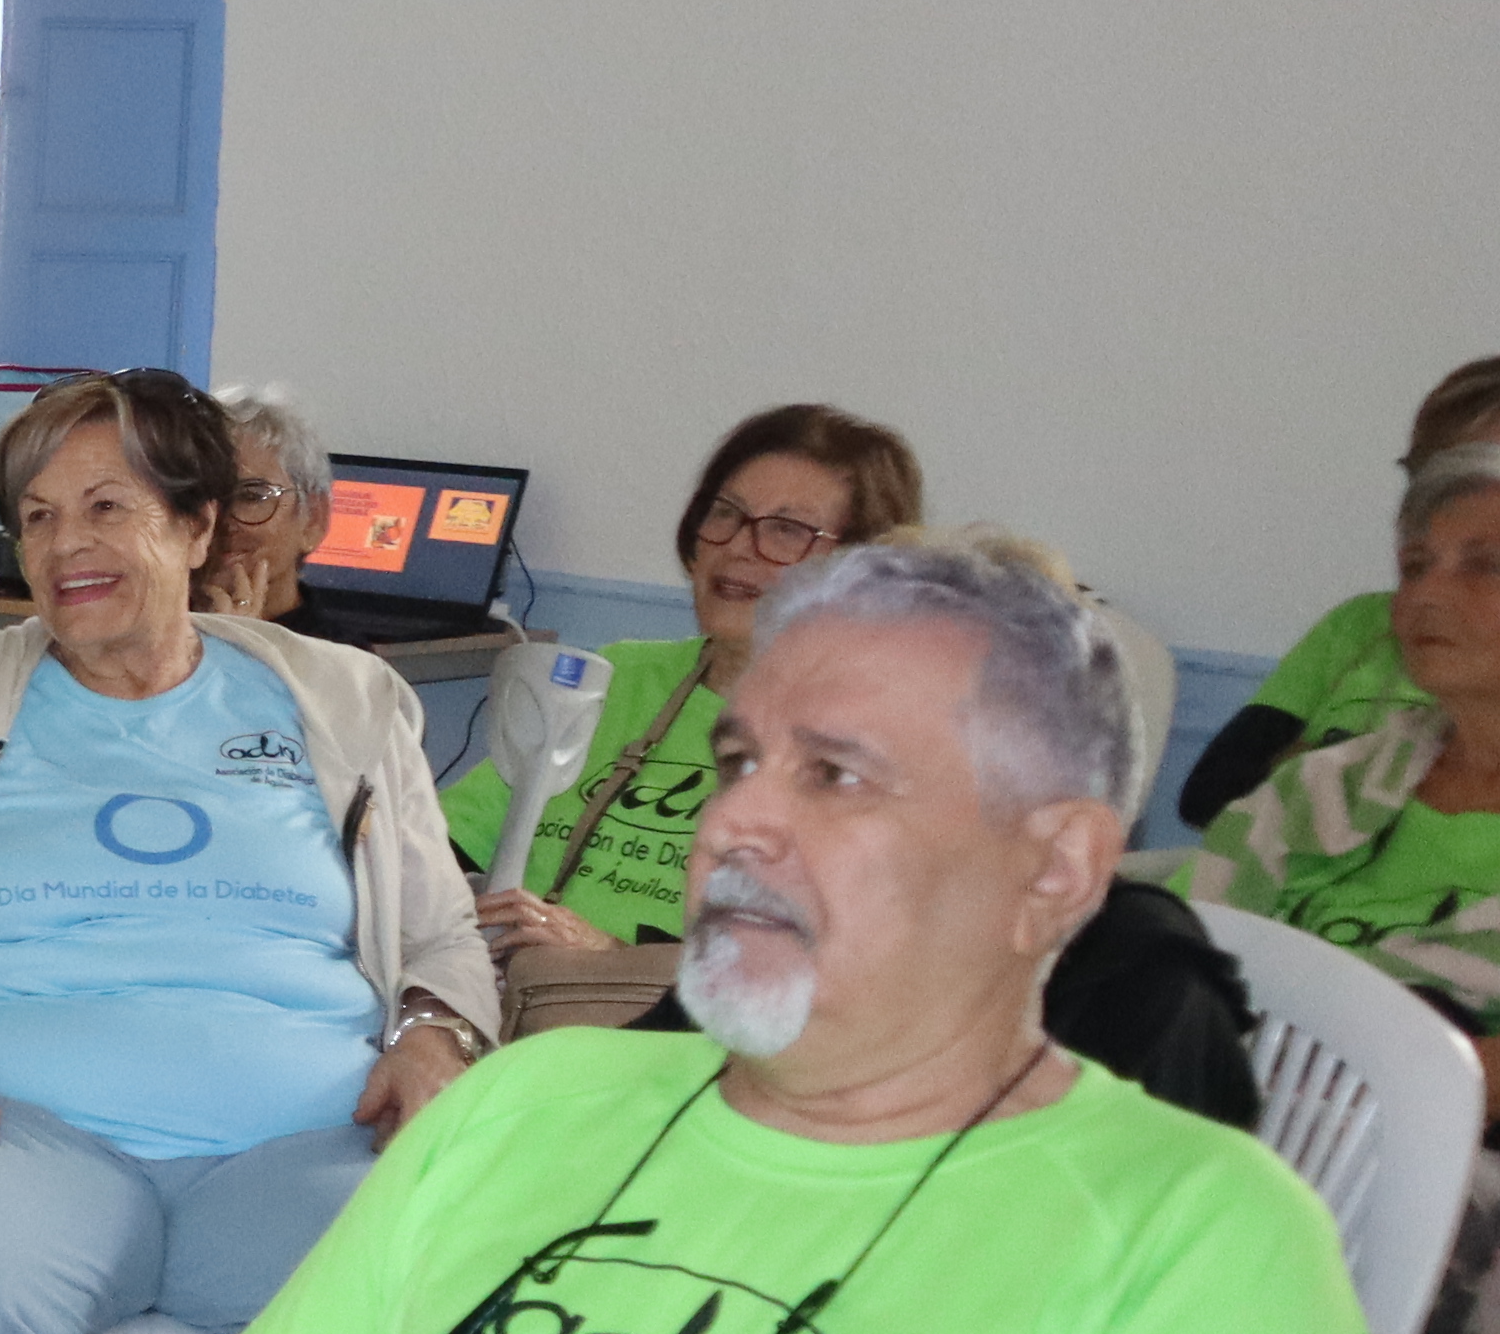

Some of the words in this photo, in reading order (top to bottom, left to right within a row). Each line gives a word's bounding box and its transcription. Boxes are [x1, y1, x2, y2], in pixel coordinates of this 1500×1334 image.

[621, 836, 650, 861] de
[42, 879, 140, 900] Mundial
[146, 879, 178, 899] de
[186, 877, 208, 899] la
[214, 879, 319, 909] Diabetes
[598, 861, 683, 905] Águilas
